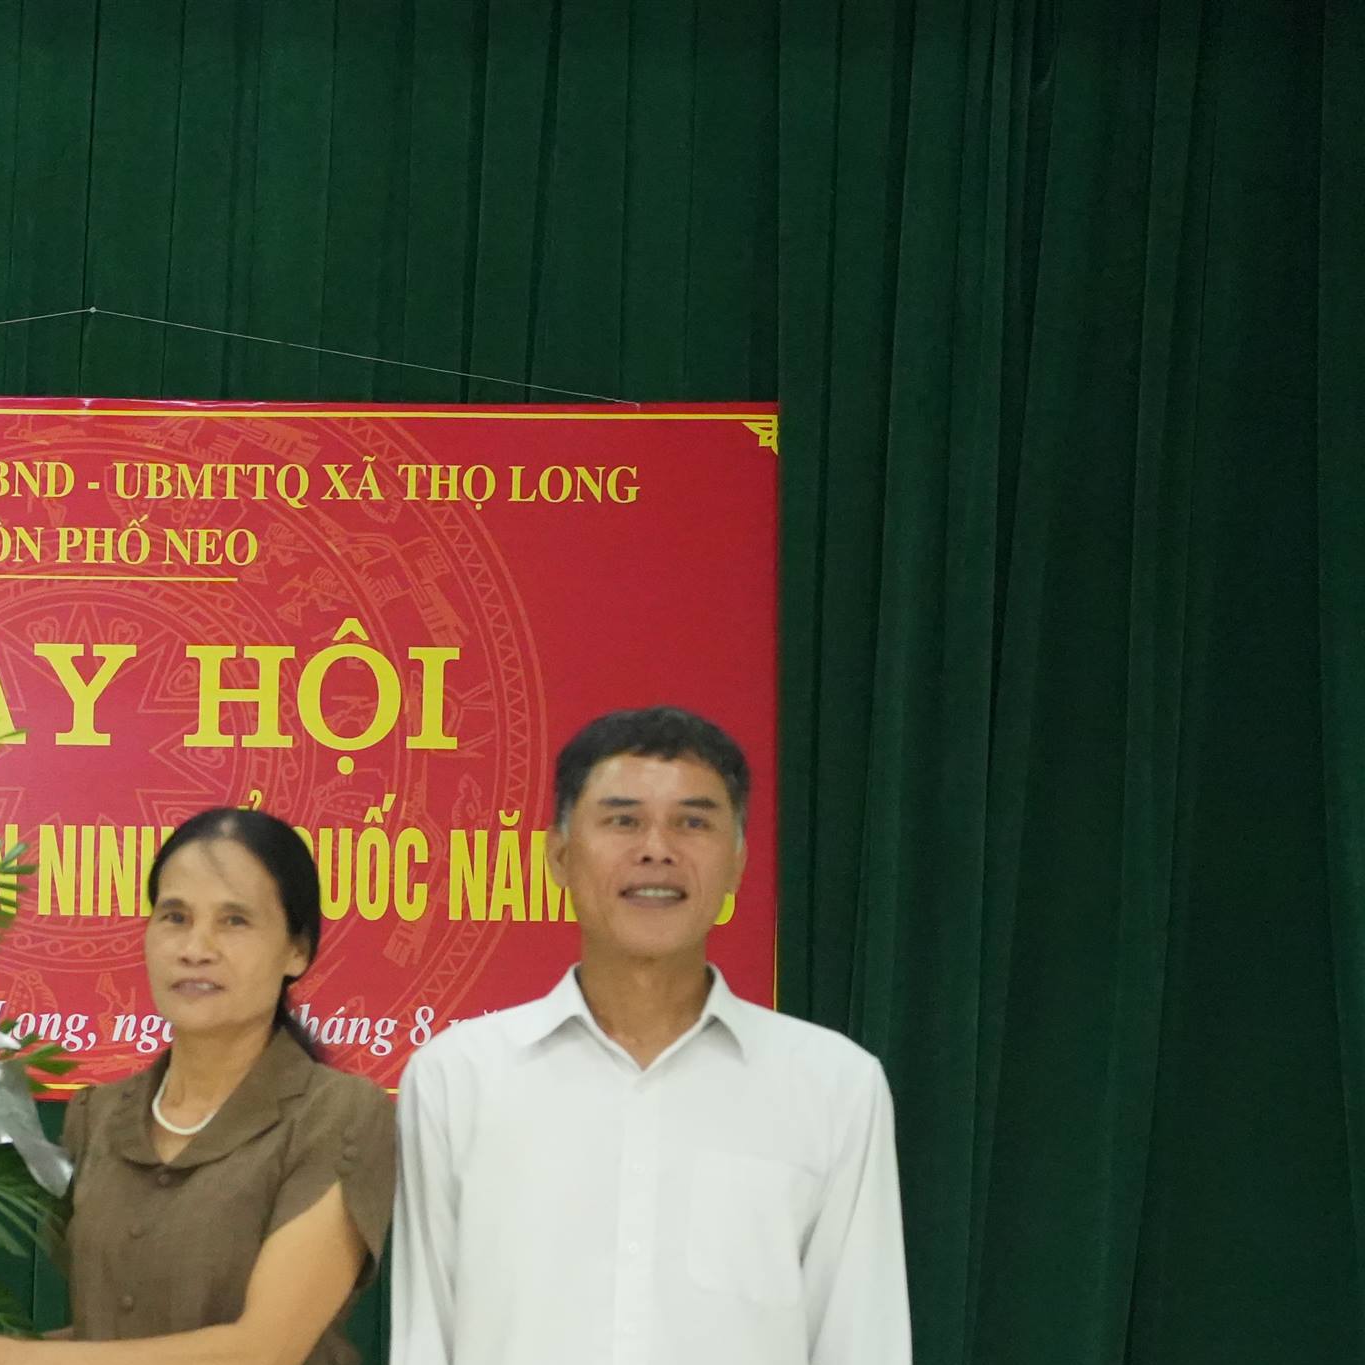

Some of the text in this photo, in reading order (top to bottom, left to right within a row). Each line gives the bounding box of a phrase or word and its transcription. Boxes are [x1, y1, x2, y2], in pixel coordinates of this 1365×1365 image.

[113, 462, 309, 508] UBMTTQ
[321, 456, 384, 500] XÃ
[397, 464, 496, 510] THỌ
[508, 465, 640, 503] LONG
[55, 515, 151, 565] PHỐ
[162, 528, 258, 566] NEO
[183, 617, 461, 775] HỘI
[292, 793, 429, 922] UỐC
[290, 1003, 398, 1056] háng
[409, 1006, 435, 1046] 8
